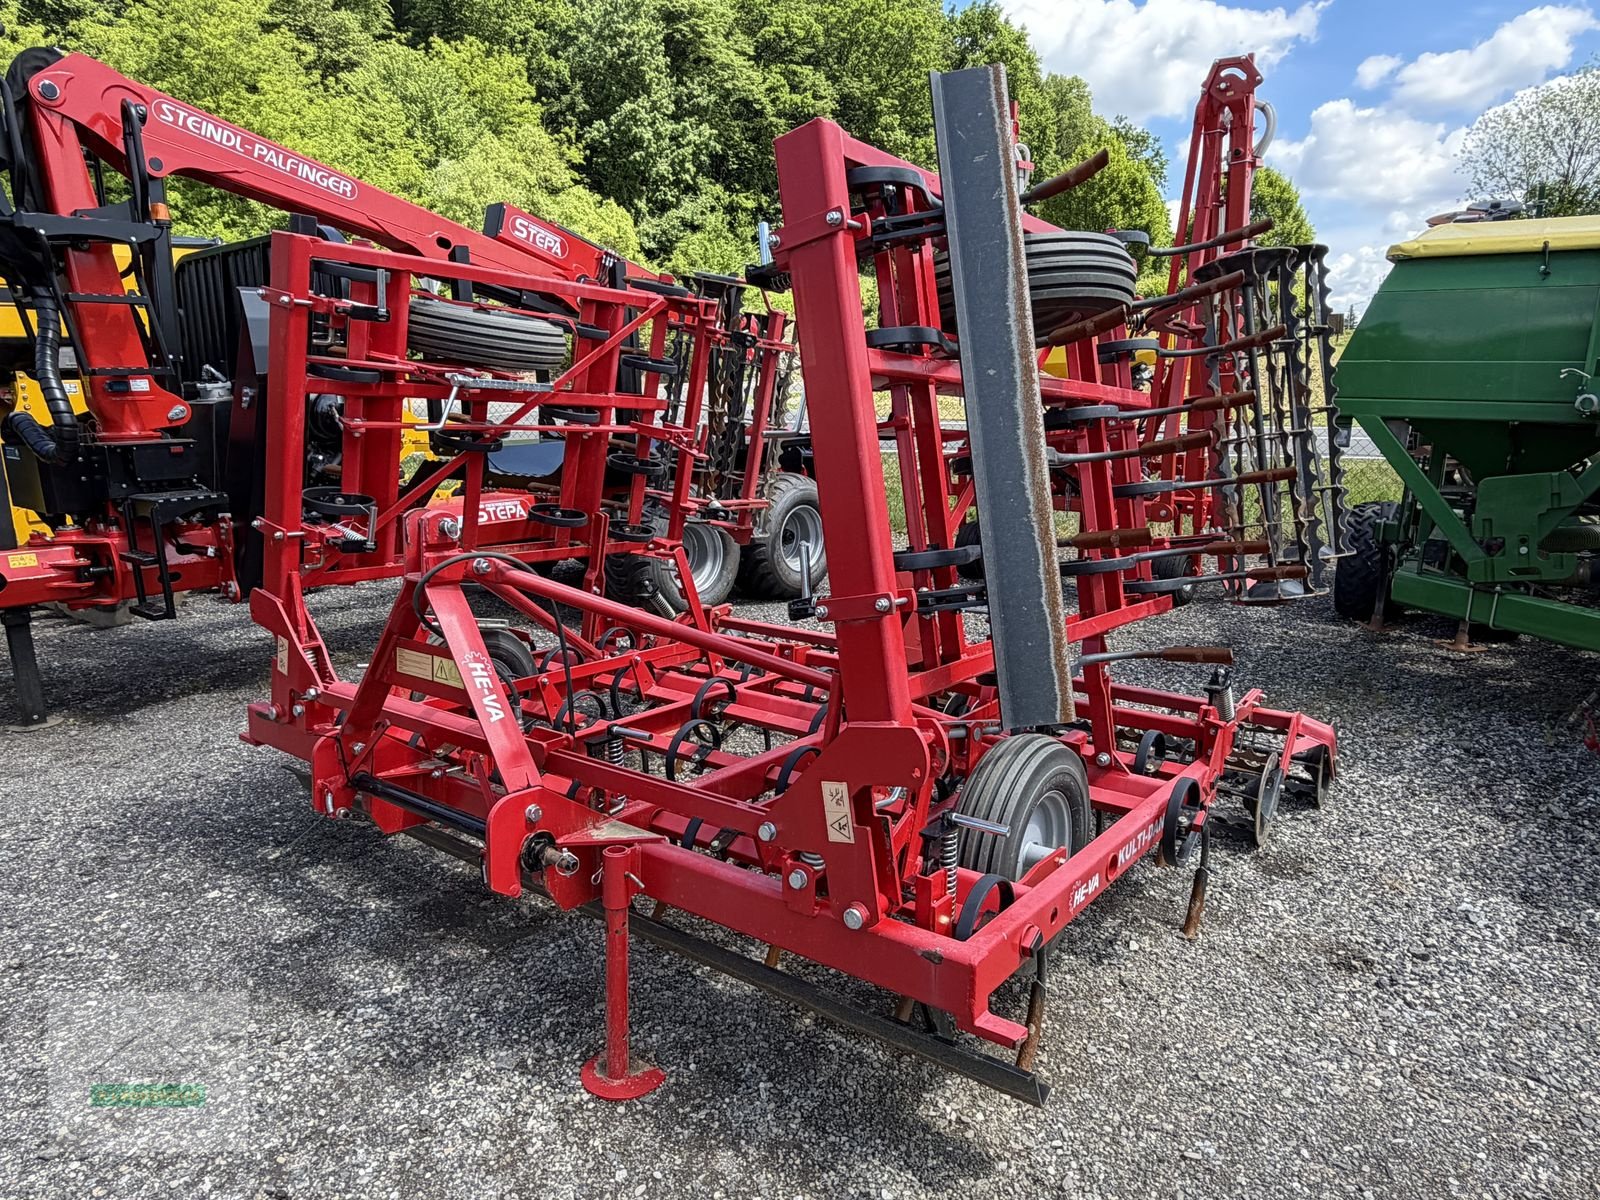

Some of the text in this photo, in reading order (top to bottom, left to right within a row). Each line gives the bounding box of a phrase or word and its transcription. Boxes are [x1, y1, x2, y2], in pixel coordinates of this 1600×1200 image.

[160, 103, 352, 197] STEINDL-PALFINGER
[514, 218, 562, 256] STEPA
[468, 662, 505, 723] HE-VA
[1073, 873, 1099, 908] HE-VA
